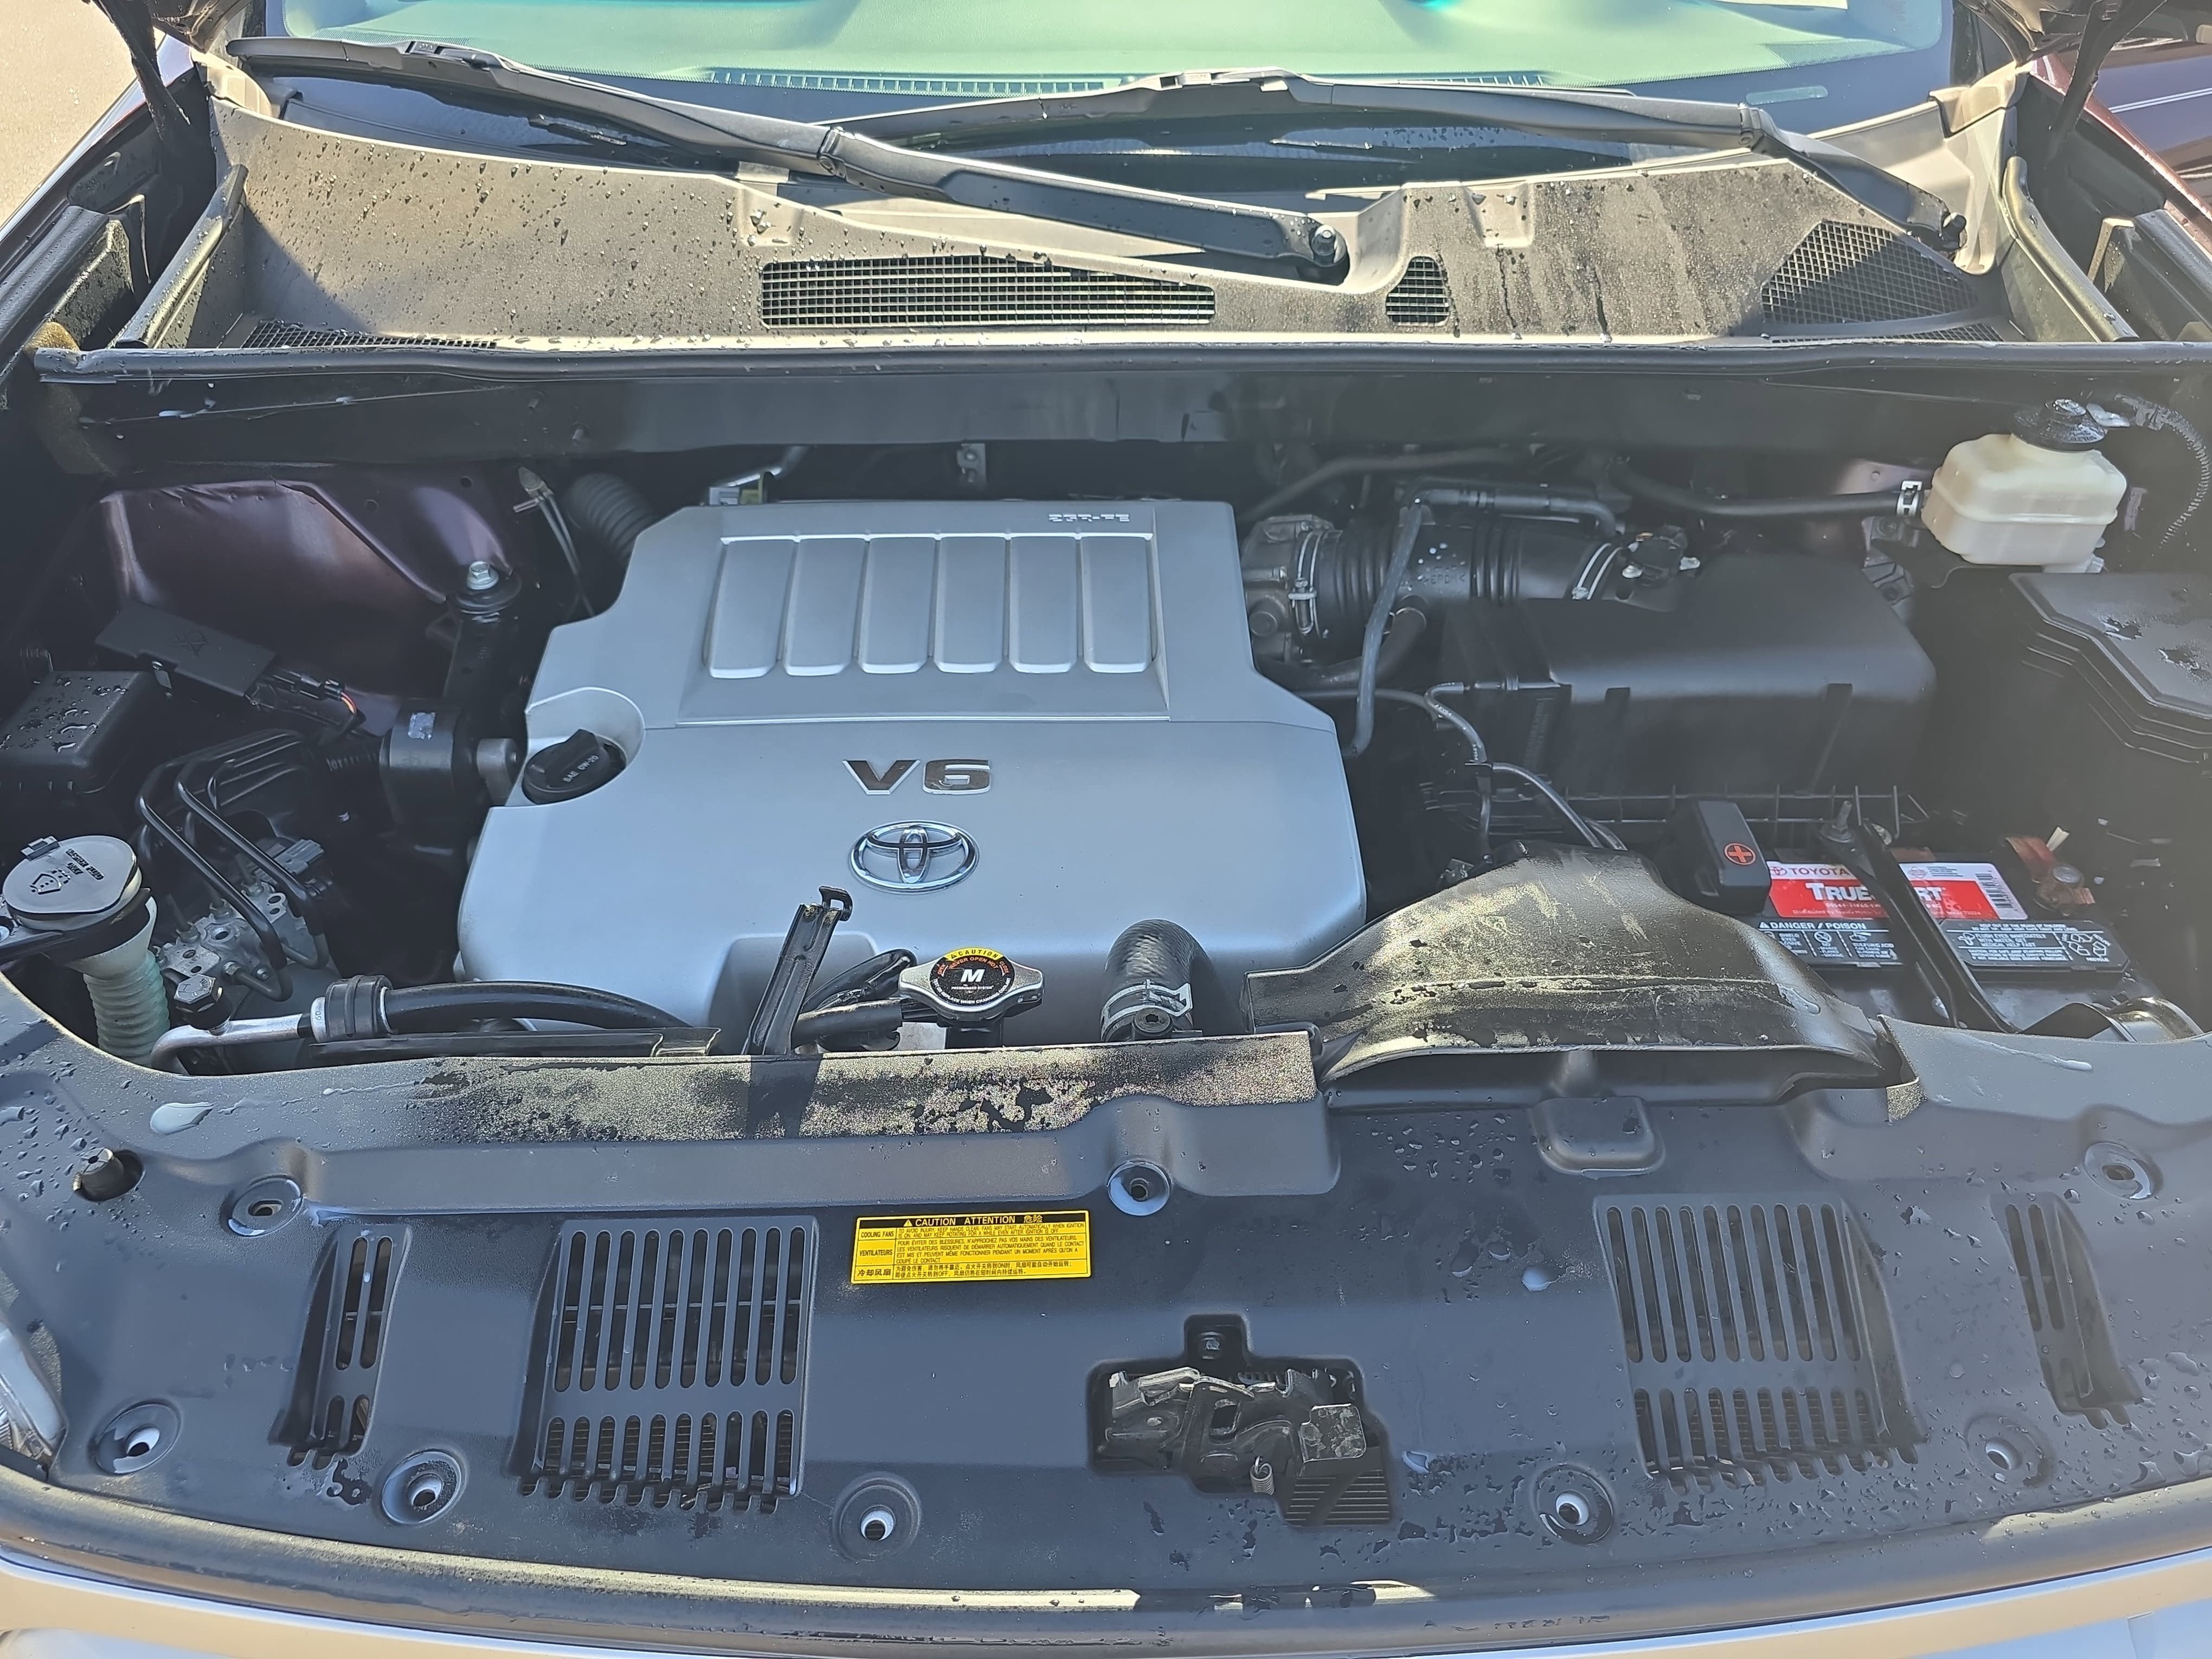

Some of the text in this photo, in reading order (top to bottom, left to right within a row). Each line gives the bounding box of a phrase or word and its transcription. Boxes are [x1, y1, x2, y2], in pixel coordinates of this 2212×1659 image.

[563, 770, 579, 782] SAE
[842, 759, 991, 795] V6
[1789, 867, 1850, 876] TOYOTA
[959, 949, 999, 958] CAUTION
[949, 957, 968, 969] NEVER
[987, 960, 999, 969] HOT
[960, 969, 985, 982] M
[915, 1216, 1015, 1226] CAUTION ATTENTION
[1024, 1215, 1043, 1223] 危险
